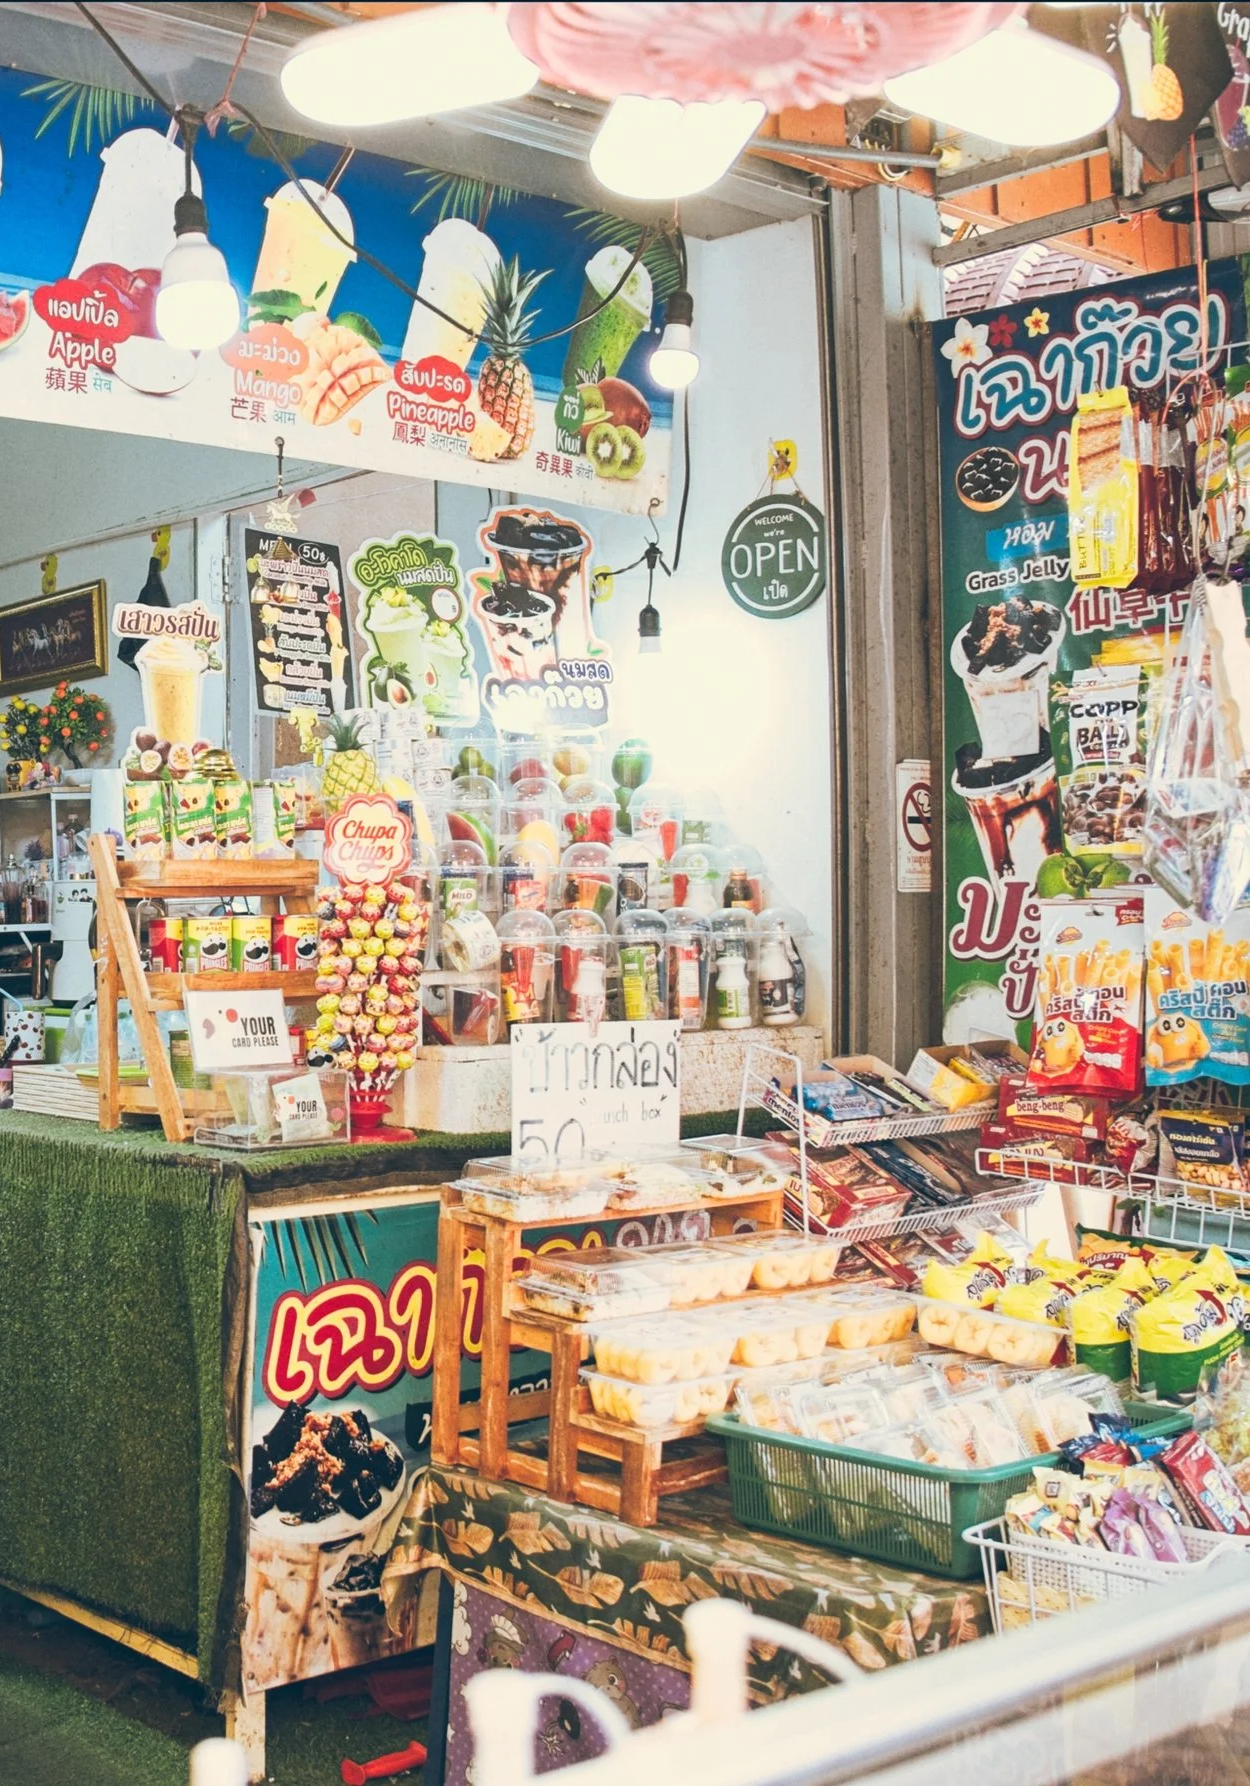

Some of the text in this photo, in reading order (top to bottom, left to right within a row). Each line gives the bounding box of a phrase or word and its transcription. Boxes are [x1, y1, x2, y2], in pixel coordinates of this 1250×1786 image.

[1217, 2, 1250, 52] Gra
[51, 331, 114, 368] Apple
[237, 336, 301, 366] มะม่วง
[958, 297, 1225, 434] เฉาก๊วย
[45, 367, 88, 394] 蘋果
[236, 369, 302, 408] Mango
[401, 366, 466, 394] สับปะรด
[230, 397, 267, 423] 芒果
[389, 393, 475, 432] Pineapple
[393, 421, 427, 447] 鳳梨
[557, 429, 581, 454] Kiwi
[535, 451, 573, 479] 奇異果
[754, 513, 794, 526] WELCOME
[763, 528, 785, 537] we're
[1003, 520, 1054, 550] หอม
[359, 543, 427, 580] อะโวคาโด
[730, 536, 819, 579] OPEN
[396, 562, 454, 587] นมสดปั่น
[968, 559, 1069, 592] Grass Jelly
[763, 579, 788, 600] เปิด
[119, 606, 218, 638] เสาวรสปั่น
[560, 660, 611, 682] นมสด
[342, 820, 398, 844] Chupa
[339, 840, 394, 866] Chups
[451, 891, 472, 901] MILO
[1210, 981, 1247, 999] คอน
[240, 1016, 276, 1036] YOUR
[232, 1036, 279, 1048] CARD PLEASE
[296, 1100, 317, 1113] YOUR
[767, 1096, 801, 1124] mentos
[1016, 1100, 1065, 1113] beng-beng
